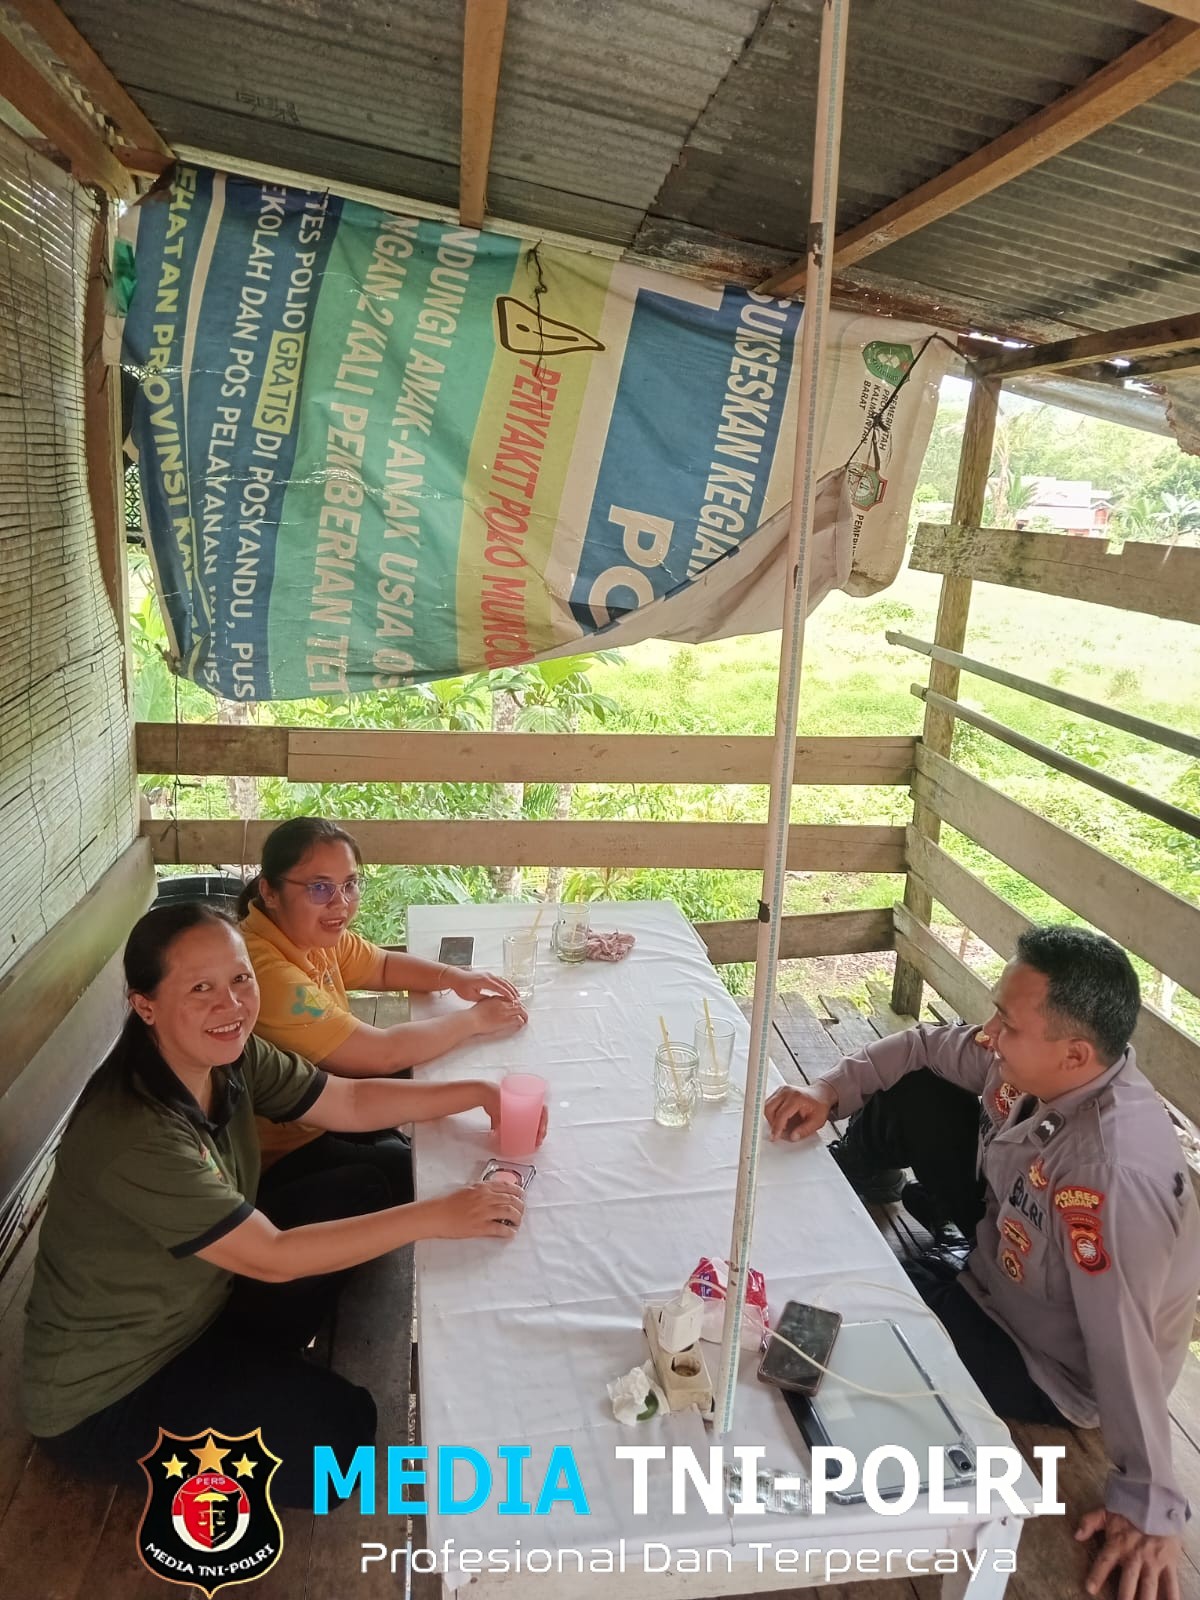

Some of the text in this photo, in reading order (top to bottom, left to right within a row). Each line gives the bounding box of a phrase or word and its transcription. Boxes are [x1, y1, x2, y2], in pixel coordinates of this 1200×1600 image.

[297, 188, 329, 244] TES
[232, 286, 267, 340] DAN
[283, 251, 316, 328] POLIO
[356, 295, 395, 325] 2
[221, 348, 255, 397] POS
[261, 337, 300, 426] GRATIS
[335, 320, 388, 395] KALI
[714, 290, 792, 463] SUKSESKAN
[858, 380, 872, 410] BARAT
[252, 432, 282, 459] DI
[383, 349, 445, 546] ANAK-ANAK
[490, 359, 561, 499] PENYAKIT
[202, 406, 240, 575] PELAYANAN
[226, 466, 274, 629] POSYANDU,
[375, 552, 418, 636] USIA
